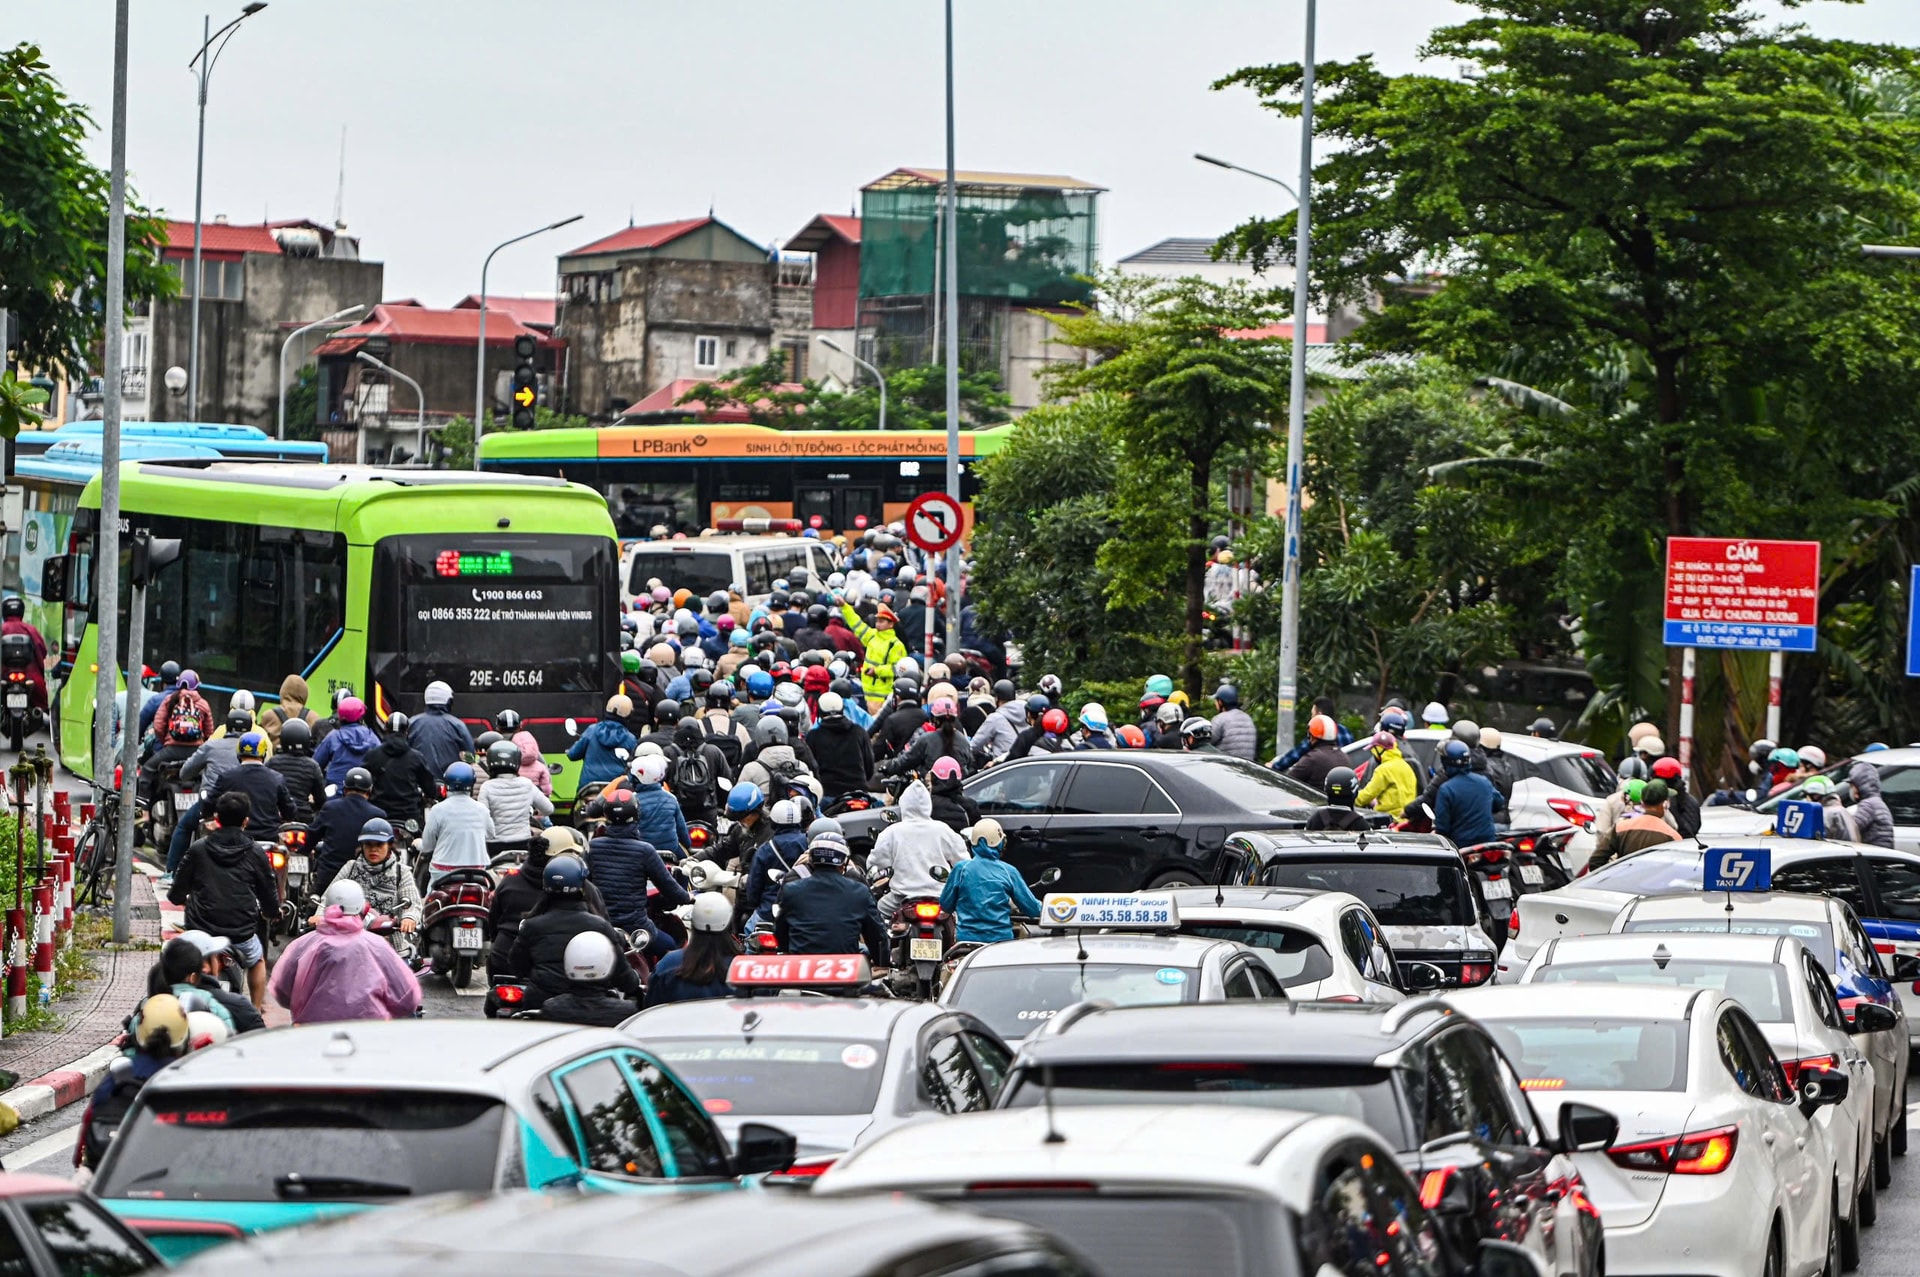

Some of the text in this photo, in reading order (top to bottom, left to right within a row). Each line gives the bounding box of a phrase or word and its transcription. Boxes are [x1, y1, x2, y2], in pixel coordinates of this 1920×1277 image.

[633, 439, 691, 453] LPBank
[746, 443, 771, 453] SINH
[773, 441, 792, 453] LỜI
[852, 440, 876, 456] LỘC
[877, 440, 905, 454] PHÁT
[929, 443, 948, 454] NG
[1726, 541, 1759, 561] CẤM
[481, 590, 542, 600] 1900 866 663
[418, 611, 430, 621] GỌI
[432, 608, 454, 620] 0866
[456, 608, 472, 620] 355
[474, 608, 491, 620] 222
[515, 609, 537, 620] THÀNH
[571, 611, 592, 620] VINBUS
[1681, 608, 1700, 618] QUA
[470, 670, 493, 686] 29E
[503, 670, 543, 686] 065.64
[1784, 805, 1804, 833] G7
[1720, 852, 1754, 886] G7
[1082, 897, 1110, 906] NINH
[1112, 897, 1138, 908] HIỆP
[1080, 910, 1168, 922] 024.35.58.58.58
[735, 959, 856, 979] Taxi 123
